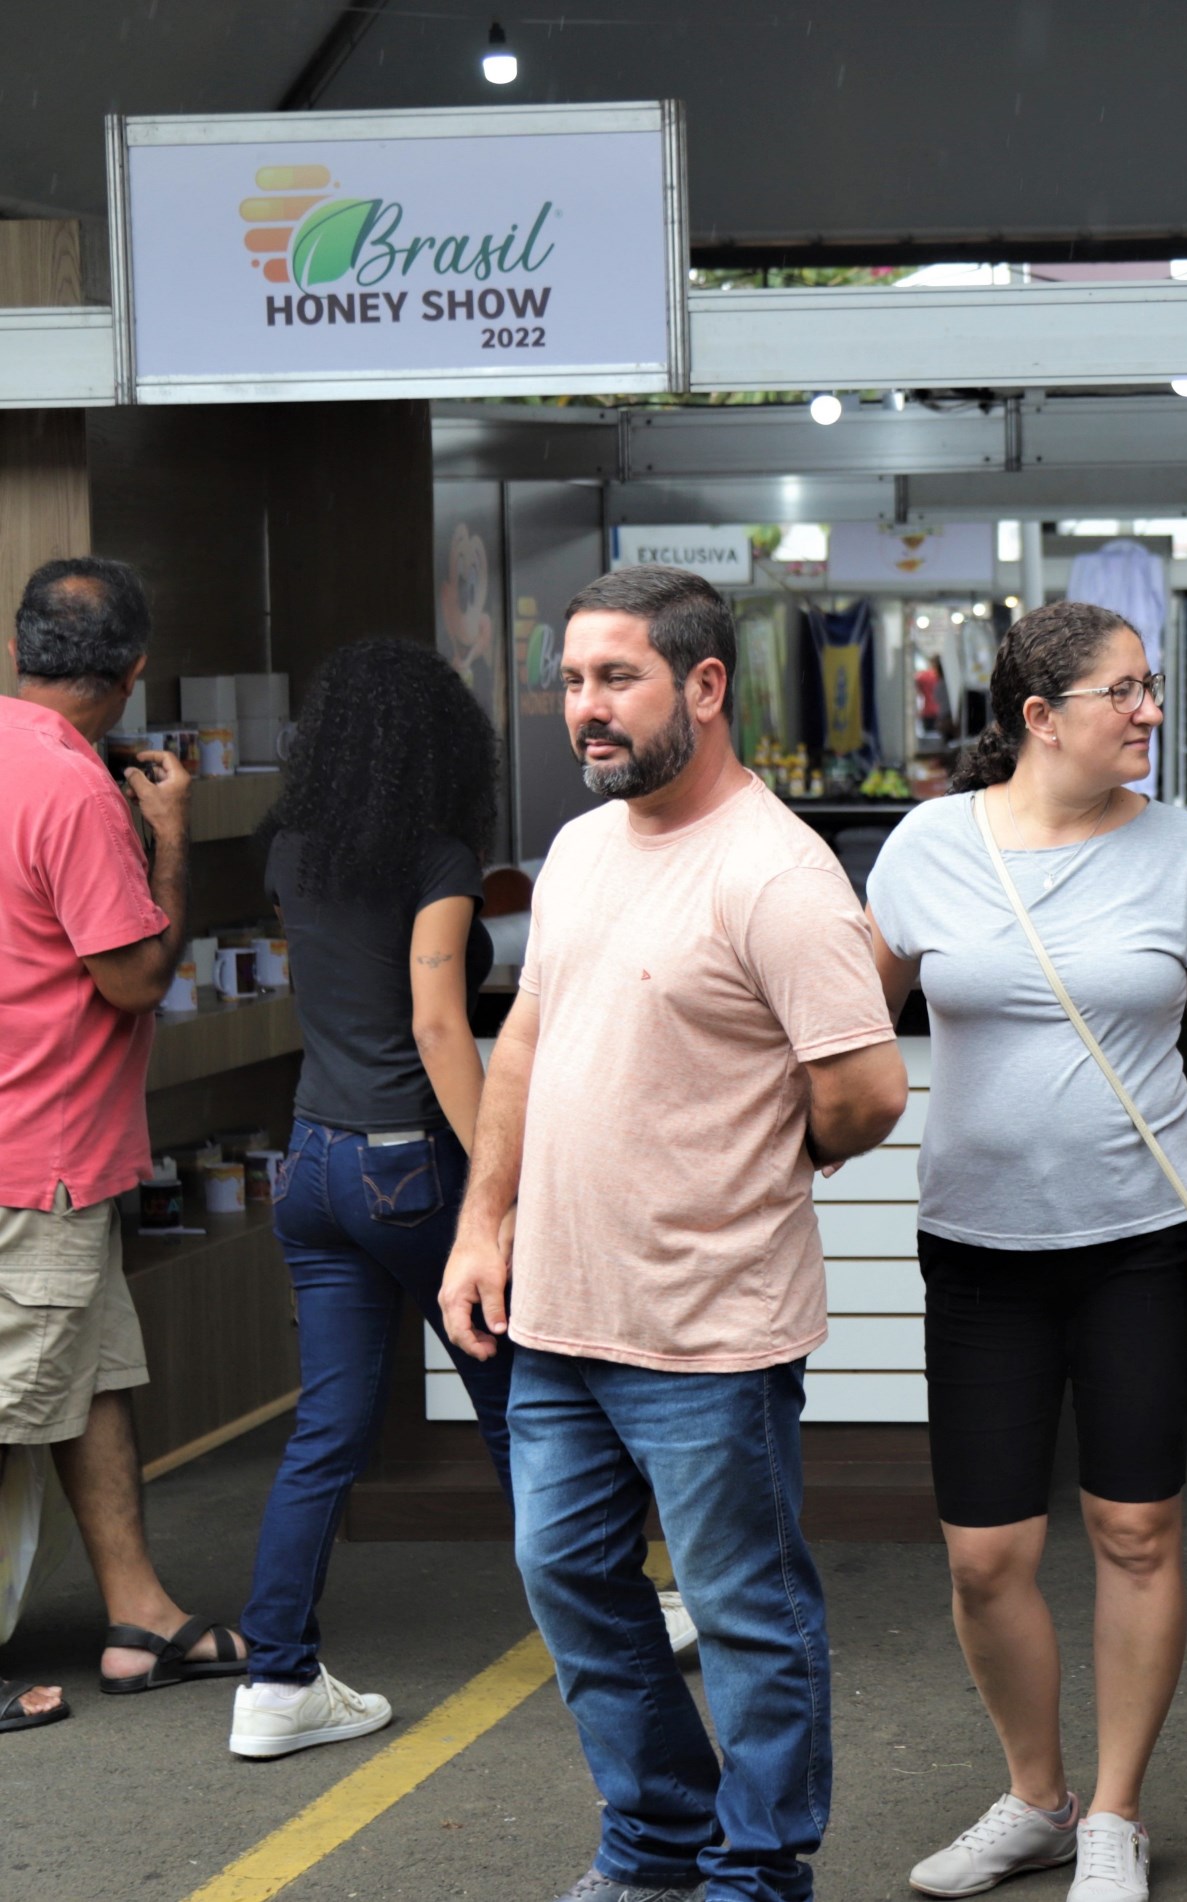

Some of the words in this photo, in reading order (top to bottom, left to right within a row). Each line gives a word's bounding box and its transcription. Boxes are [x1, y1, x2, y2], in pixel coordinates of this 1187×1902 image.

[350, 198, 556, 287] Brasil
[265, 291, 408, 327] HONEY
[421, 286, 552, 322] SHOW
[480, 326, 546, 350] 2022
[637, 546, 738, 565] EXCLUSIVA
